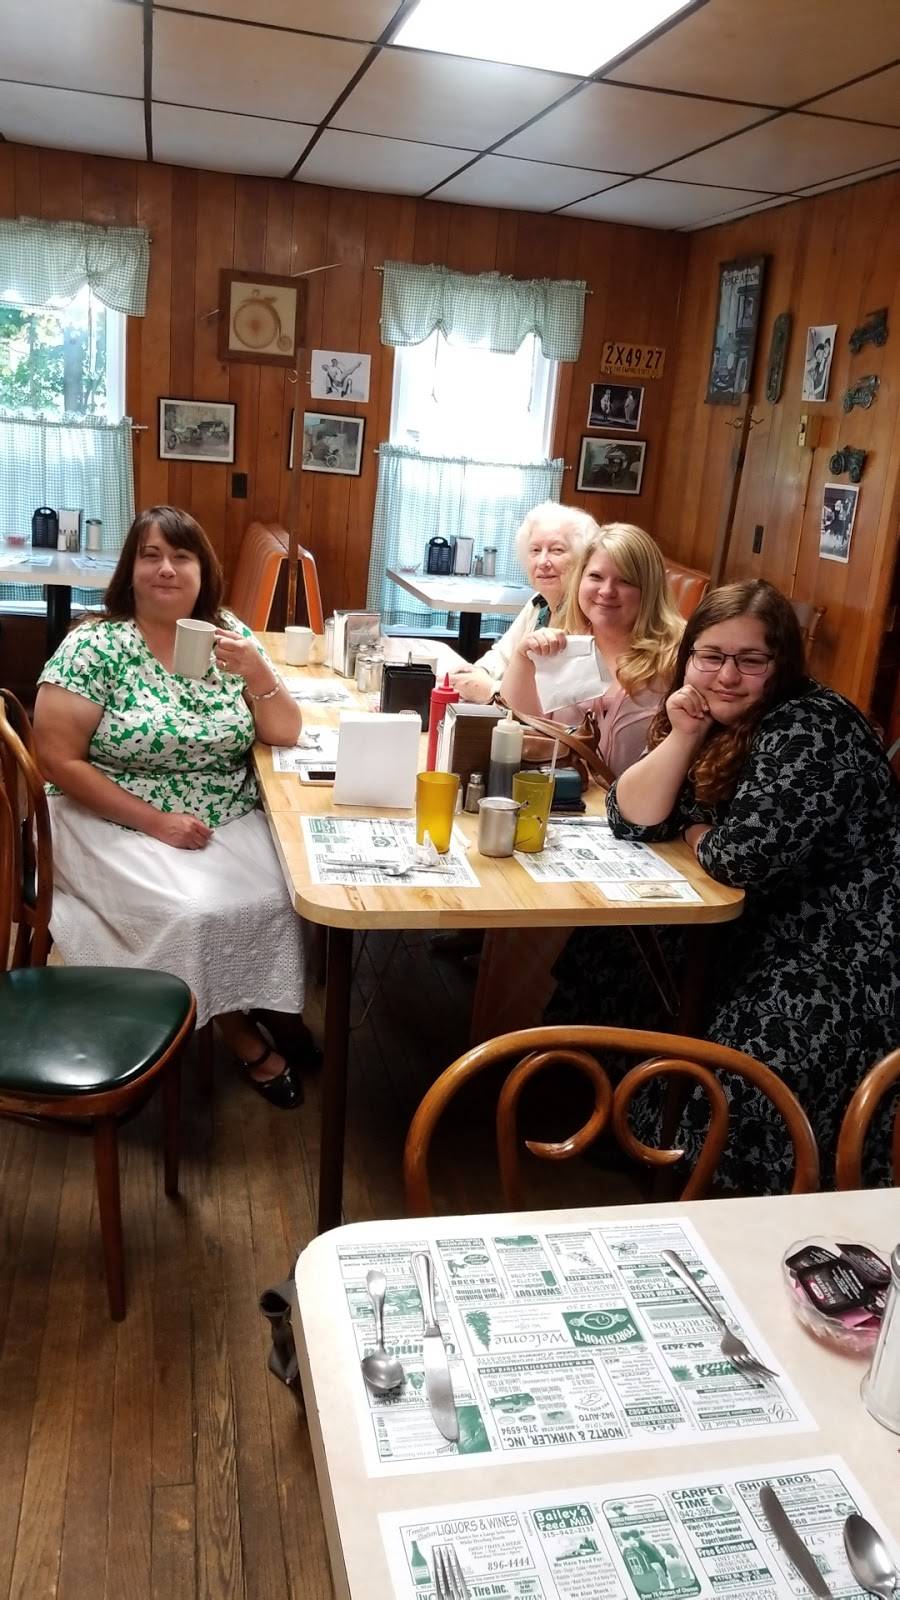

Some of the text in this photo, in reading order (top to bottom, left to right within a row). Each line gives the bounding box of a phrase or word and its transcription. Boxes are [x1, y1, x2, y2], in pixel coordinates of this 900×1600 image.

[515, 1287, 561, 1298] SWARTOUT
[652, 1318, 733, 1331] CNSTRUCTION
[493, 1333, 568, 1348] Welcome
[573, 1326, 636, 1347] FORESTPORT
[578, 1412, 615, 1422] 942-AUTO
[501, 1424, 537, 1436] 376-6594
[577, 1431, 586, 1440] &
[588, 1427, 624, 1440] NORTZ
[503, 1436, 526, 1448] INC.
[527, 1432, 577, 1446] VIRKLER,
[777, 1474, 816, 1487] BROS.
[671, 1486, 724, 1500] CARPET
[675, 1498, 710, 1510] TIME
[535, 1506, 588, 1522] Bailey's
[436, 1519, 479, 1536] LIQUORS
[479, 1519, 488, 1531] &
[488, 1515, 518, 1530] WINES
[538, 1516, 591, 1531] Feed Mill
[697, 1541, 756, 1558] Free Estimates
[472, 1586, 491, 1598] Tire
[492, 1584, 509, 1594] Inc.
